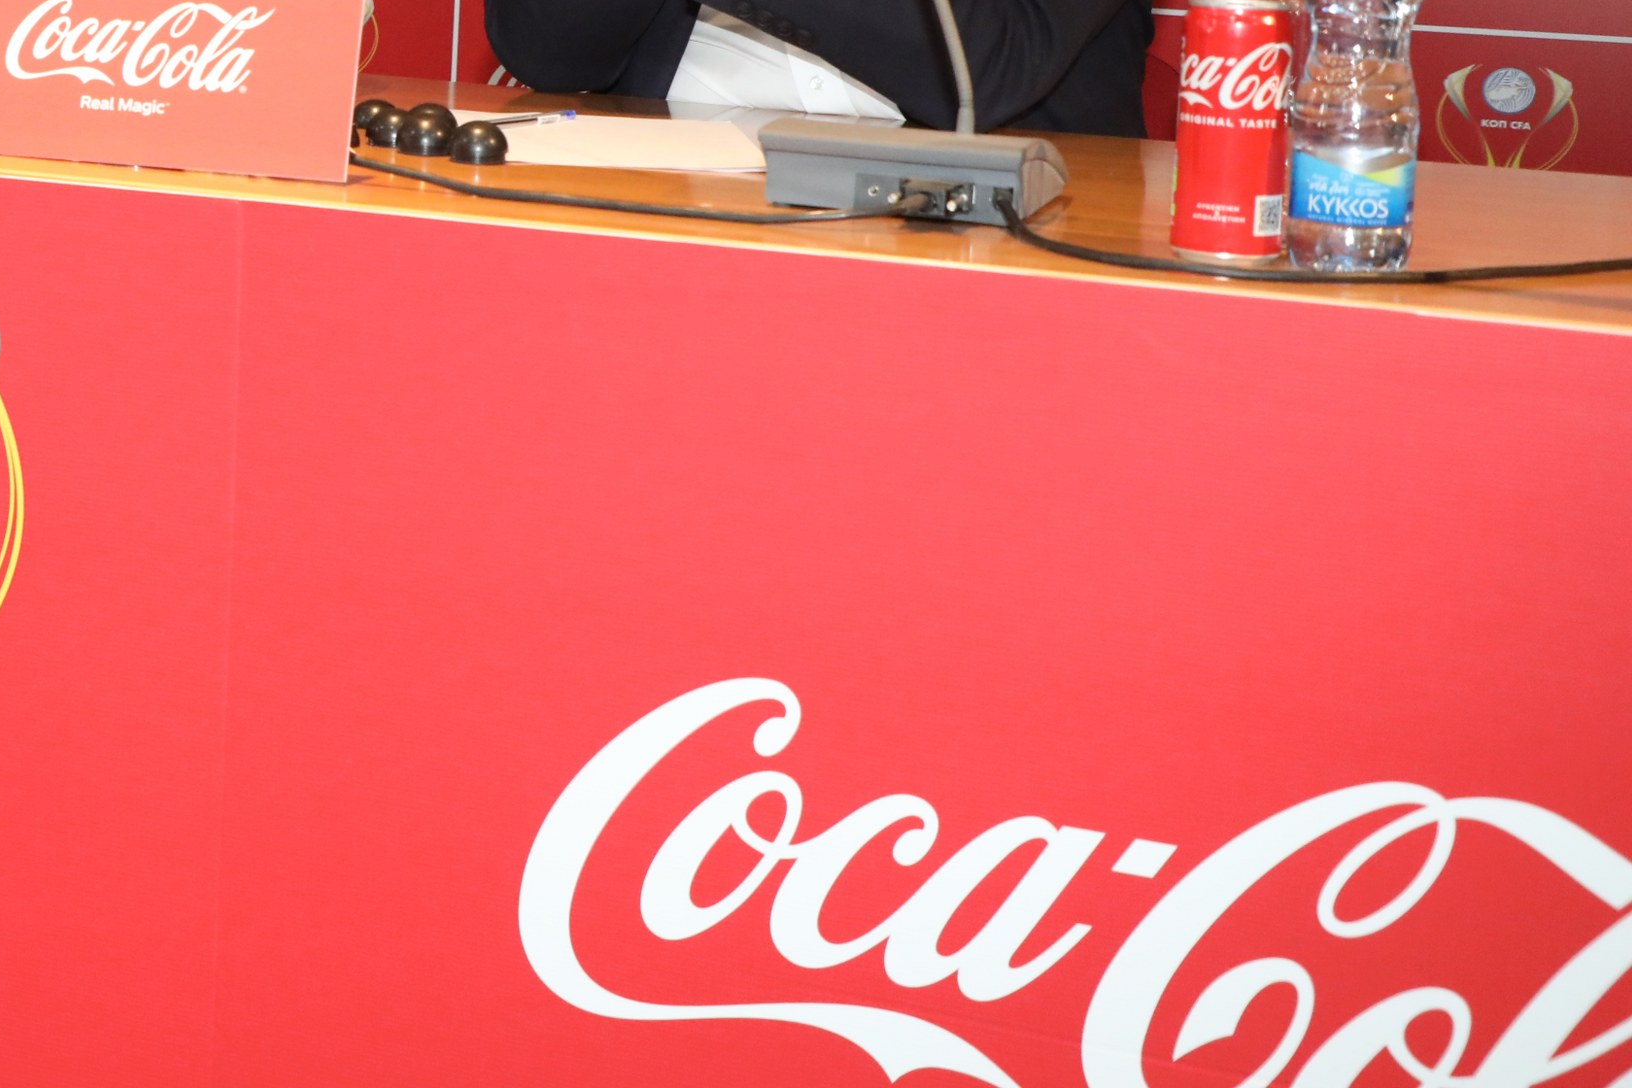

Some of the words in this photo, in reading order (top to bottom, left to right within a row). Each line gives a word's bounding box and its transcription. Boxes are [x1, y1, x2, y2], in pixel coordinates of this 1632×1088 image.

[79, 95, 115, 111] Real
[117, 97, 166, 117] Magic
[1239, 118, 1277, 129] TASTE
[518, 677, 1632, 1088] Coca-Co
